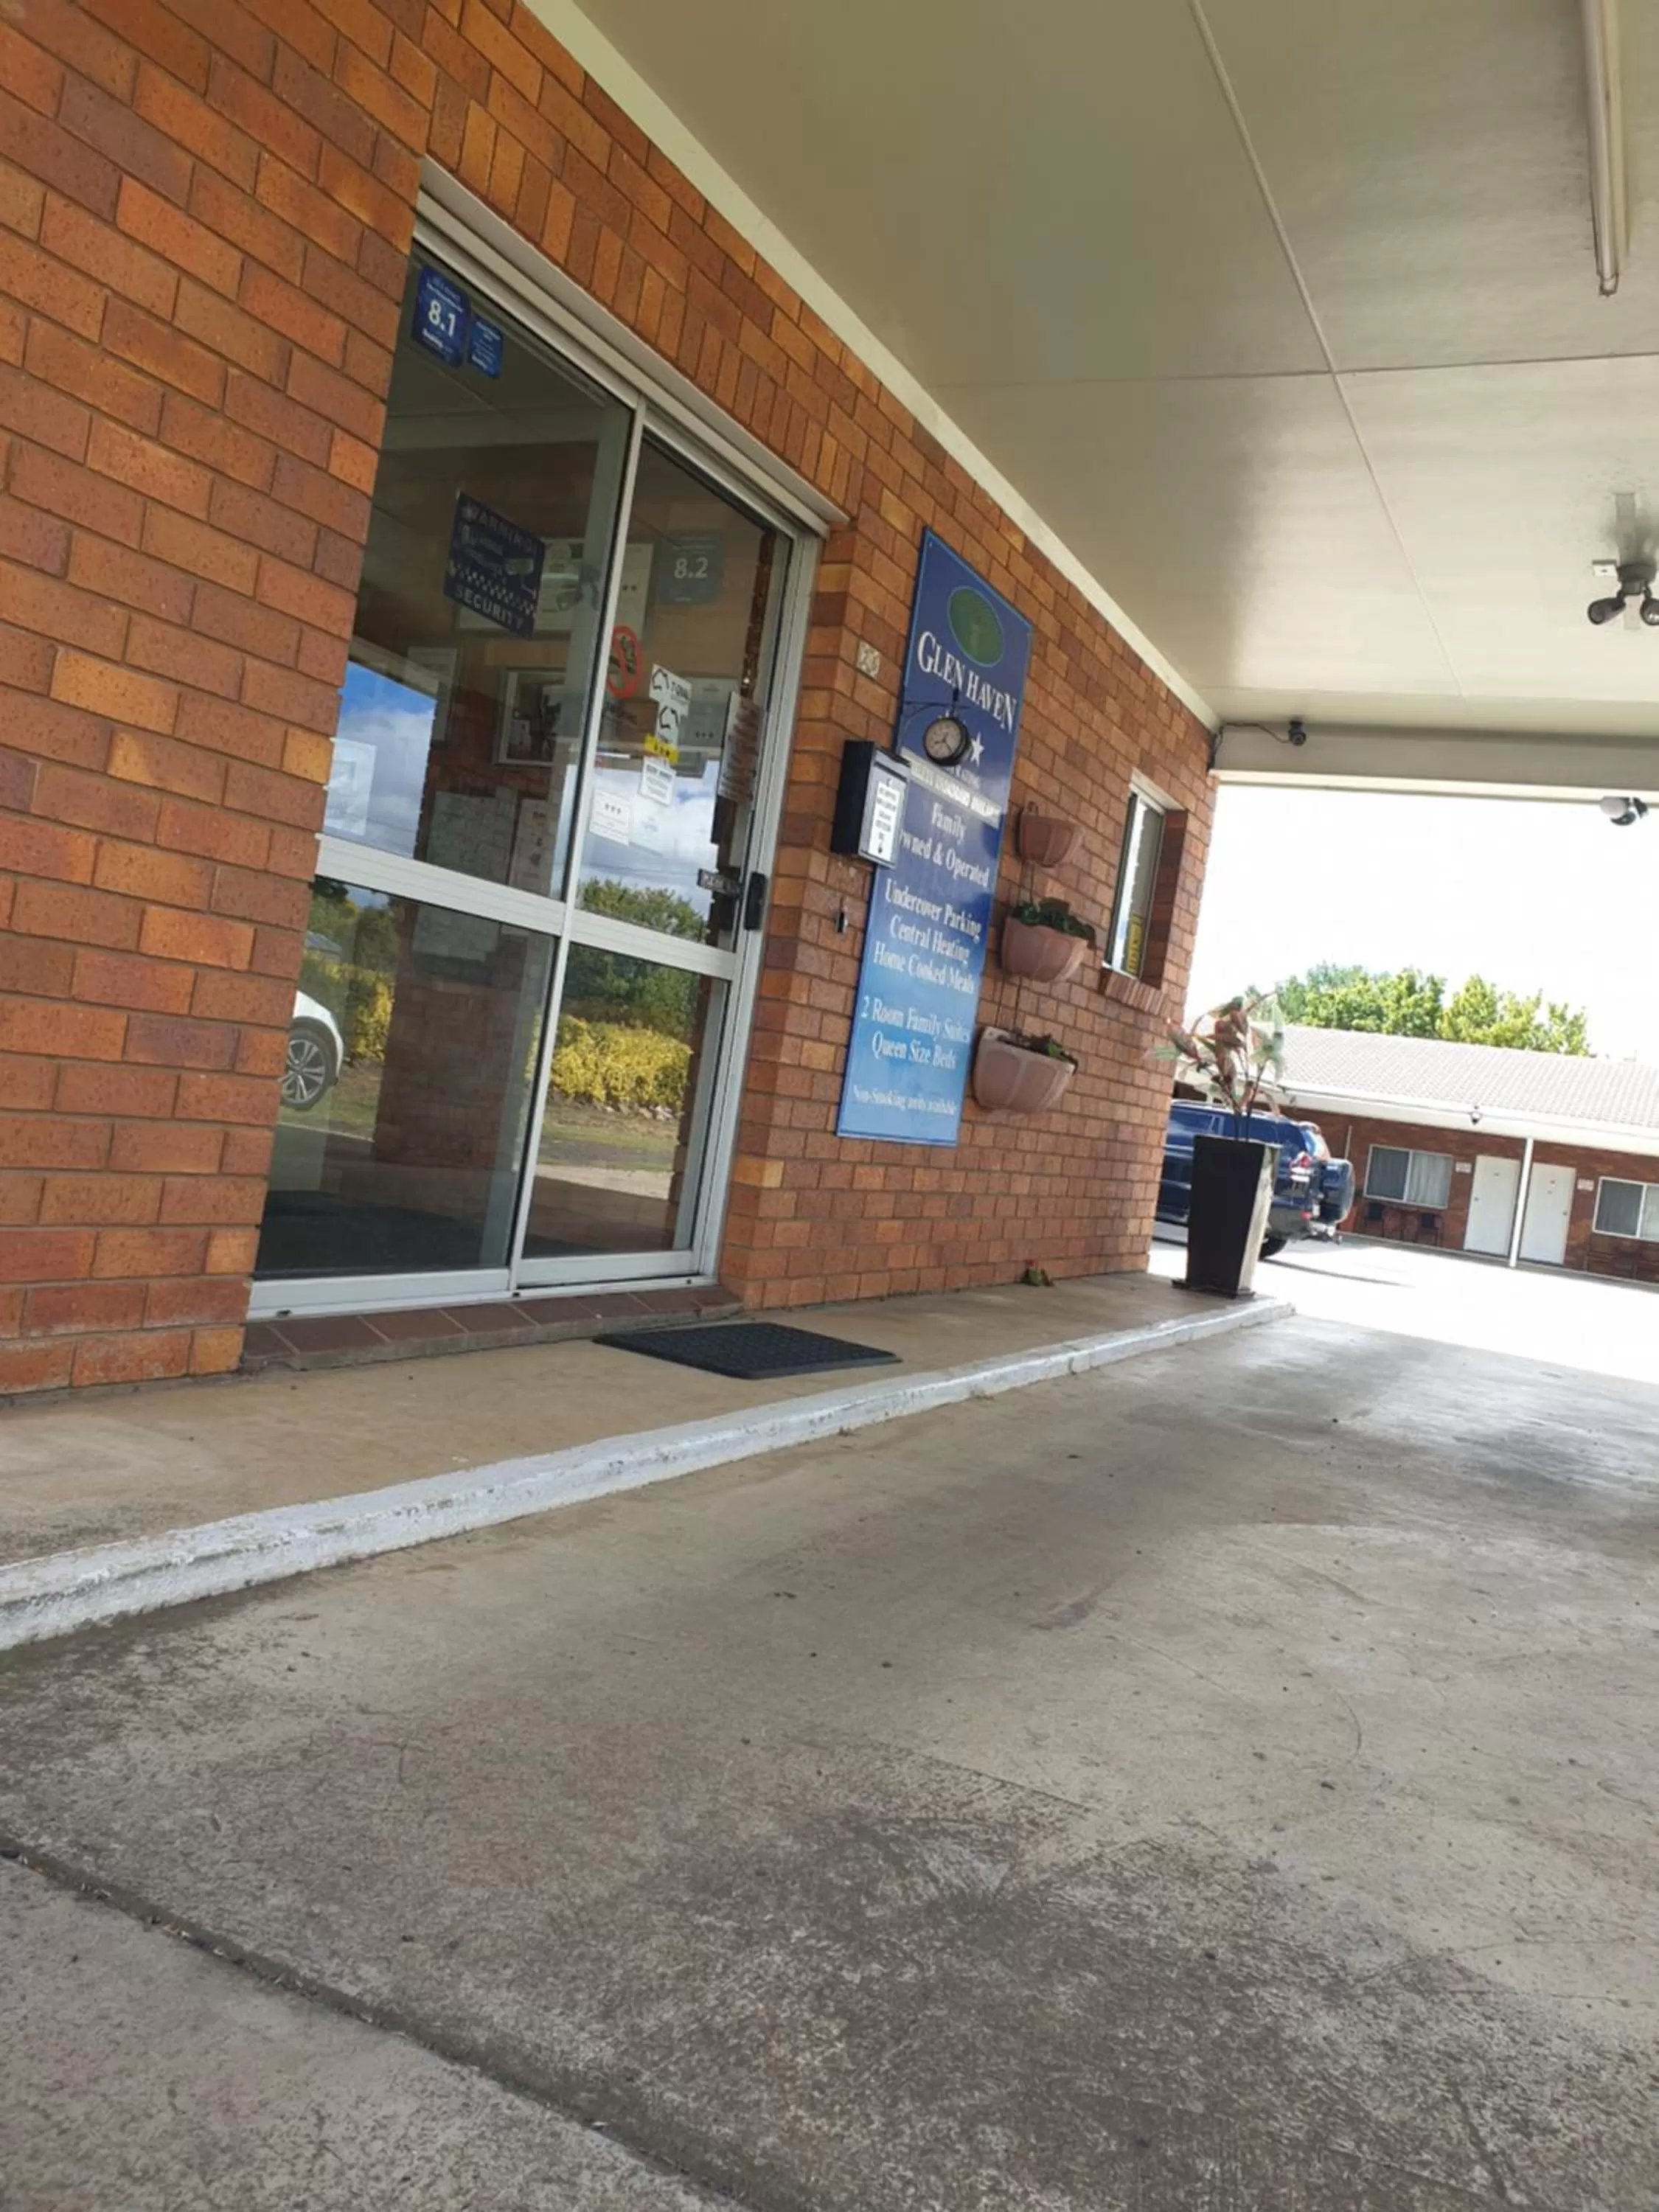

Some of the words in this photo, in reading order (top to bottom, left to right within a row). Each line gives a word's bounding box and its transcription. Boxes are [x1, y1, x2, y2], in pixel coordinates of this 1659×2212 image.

[428, 299, 456, 337] 8.1
[674, 557, 709, 579] 8.2
[455, 583, 524, 629] SECURITY
[917, 631, 965, 692] GLEN
[966, 670, 1017, 734] HAVEN
[932, 802, 966, 845] Family
[897, 830, 932, 859] wned
[933, 842, 943, 866] &
[946, 848, 990, 887] Operated
[885, 878, 942, 921] Undercover
[944, 903, 981, 944] Parking
[890, 914, 931, 949] Central
[932, 931, 970, 966] Heating
[873, 941, 905, 972] Home
[908, 954, 947, 985] Cooked
[947, 967, 974, 994] Meals
[860, 995, 870, 1018] 2
[872, 997, 904, 1027] Room
[906, 1007, 941, 1041] Family
[872, 1031, 907, 1060] Queen
[908, 1039, 931, 1063] Size
[932, 1044, 956, 1068] Beds
